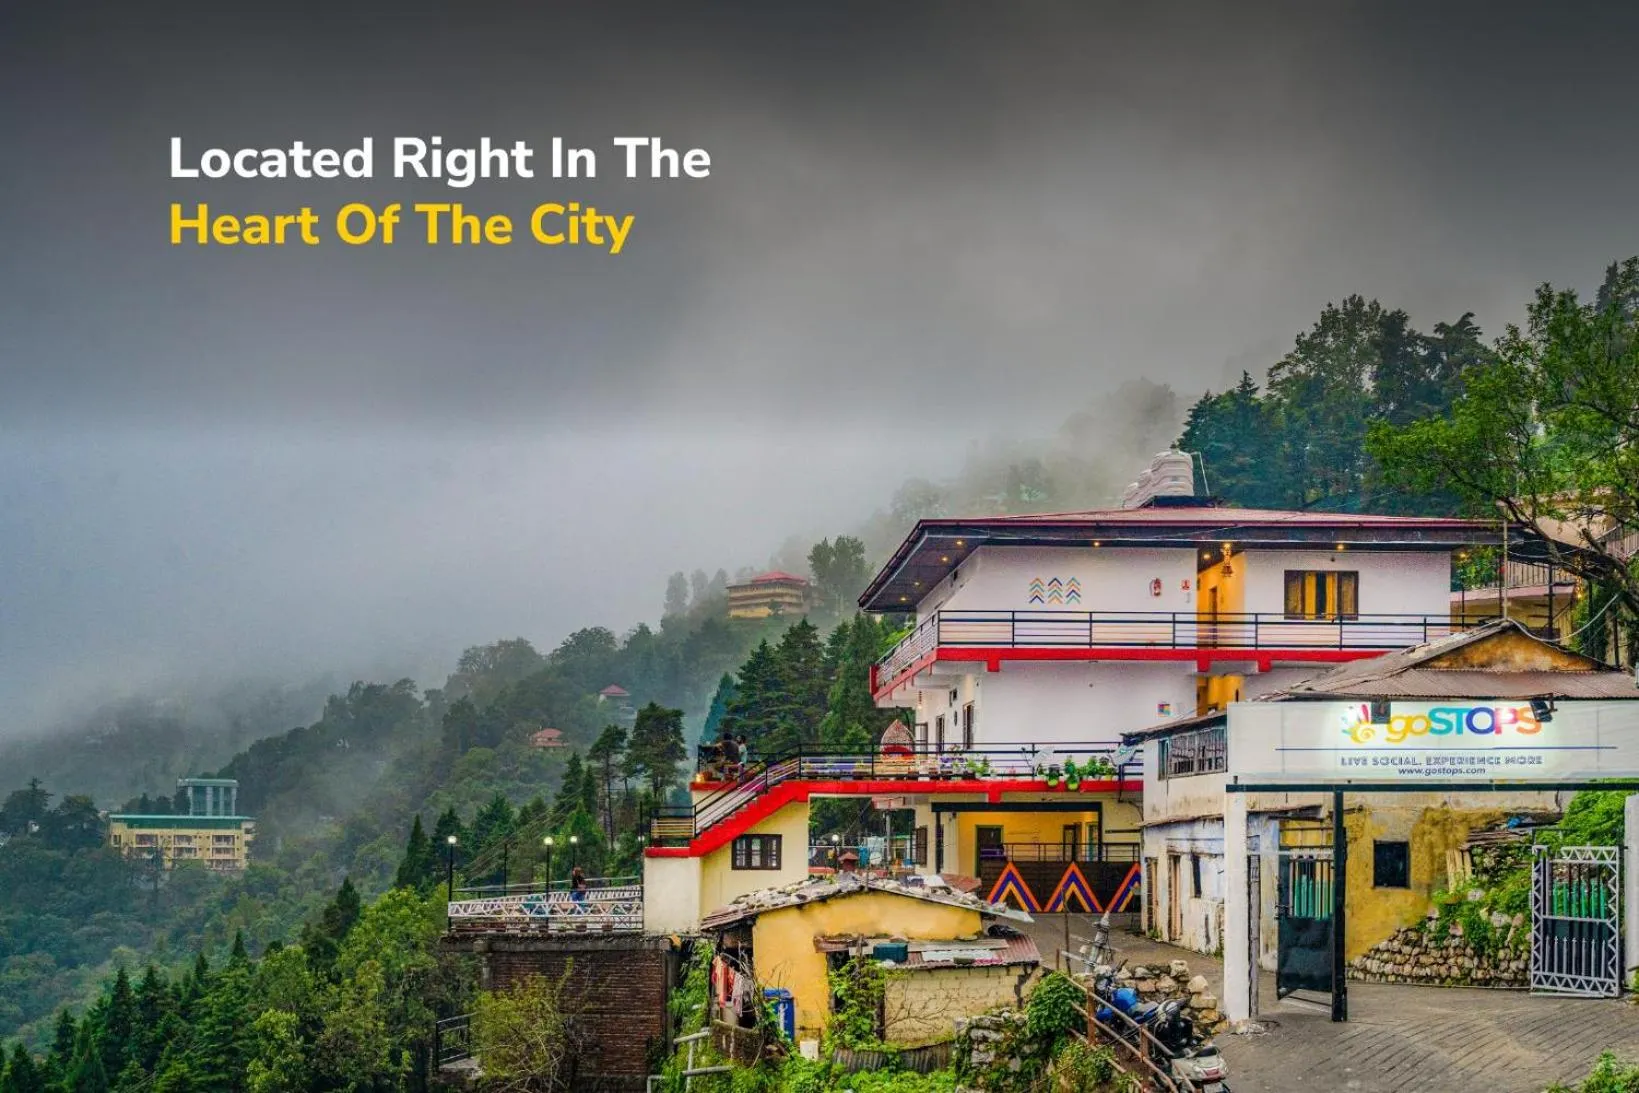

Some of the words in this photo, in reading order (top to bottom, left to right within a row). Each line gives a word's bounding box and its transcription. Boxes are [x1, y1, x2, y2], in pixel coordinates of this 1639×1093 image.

[1385, 706, 1542, 743] goSTOPS
[1341, 757, 1368, 766] LIVE
[1426, 756, 1501, 765] EXPERIENCE
[1504, 755, 1542, 765] MORE
[1398, 767, 1486, 776] www.gostops.com
